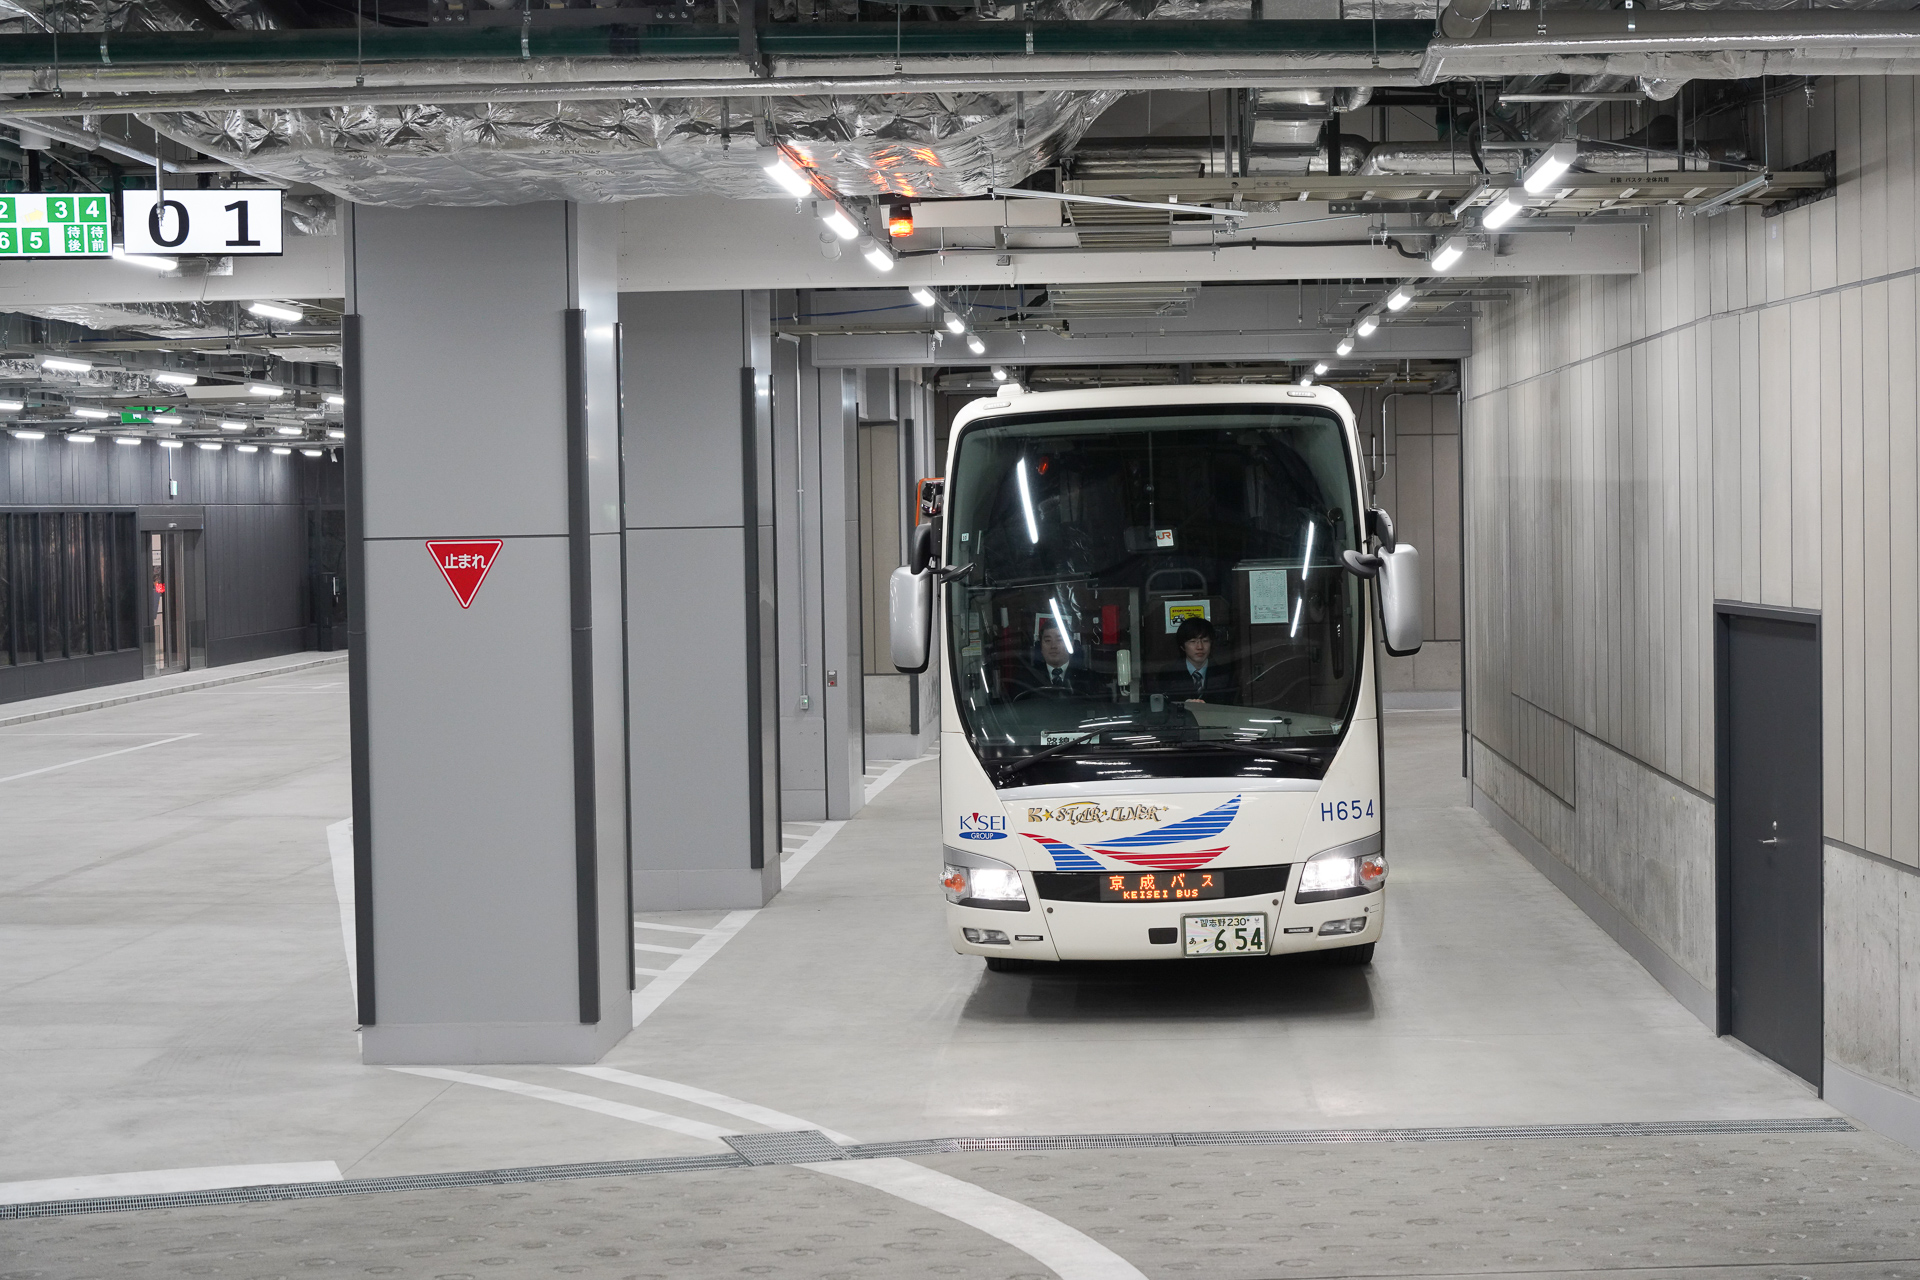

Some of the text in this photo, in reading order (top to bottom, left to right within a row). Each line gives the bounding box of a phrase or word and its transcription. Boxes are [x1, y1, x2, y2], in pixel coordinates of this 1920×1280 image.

[54, 201, 68, 218] 3
[86, 200, 99, 218] 4
[0, 231, 43, 249] 6 5
[1157, 531, 1172, 540] JR
[444, 553, 486, 570] 止まれ
[1321, 799, 1374, 821] H654
[970, 832, 994, 840] GROUP
[1123, 889, 1199, 899] KEISEI BUS
[1189, 937, 1197, 945] あ
